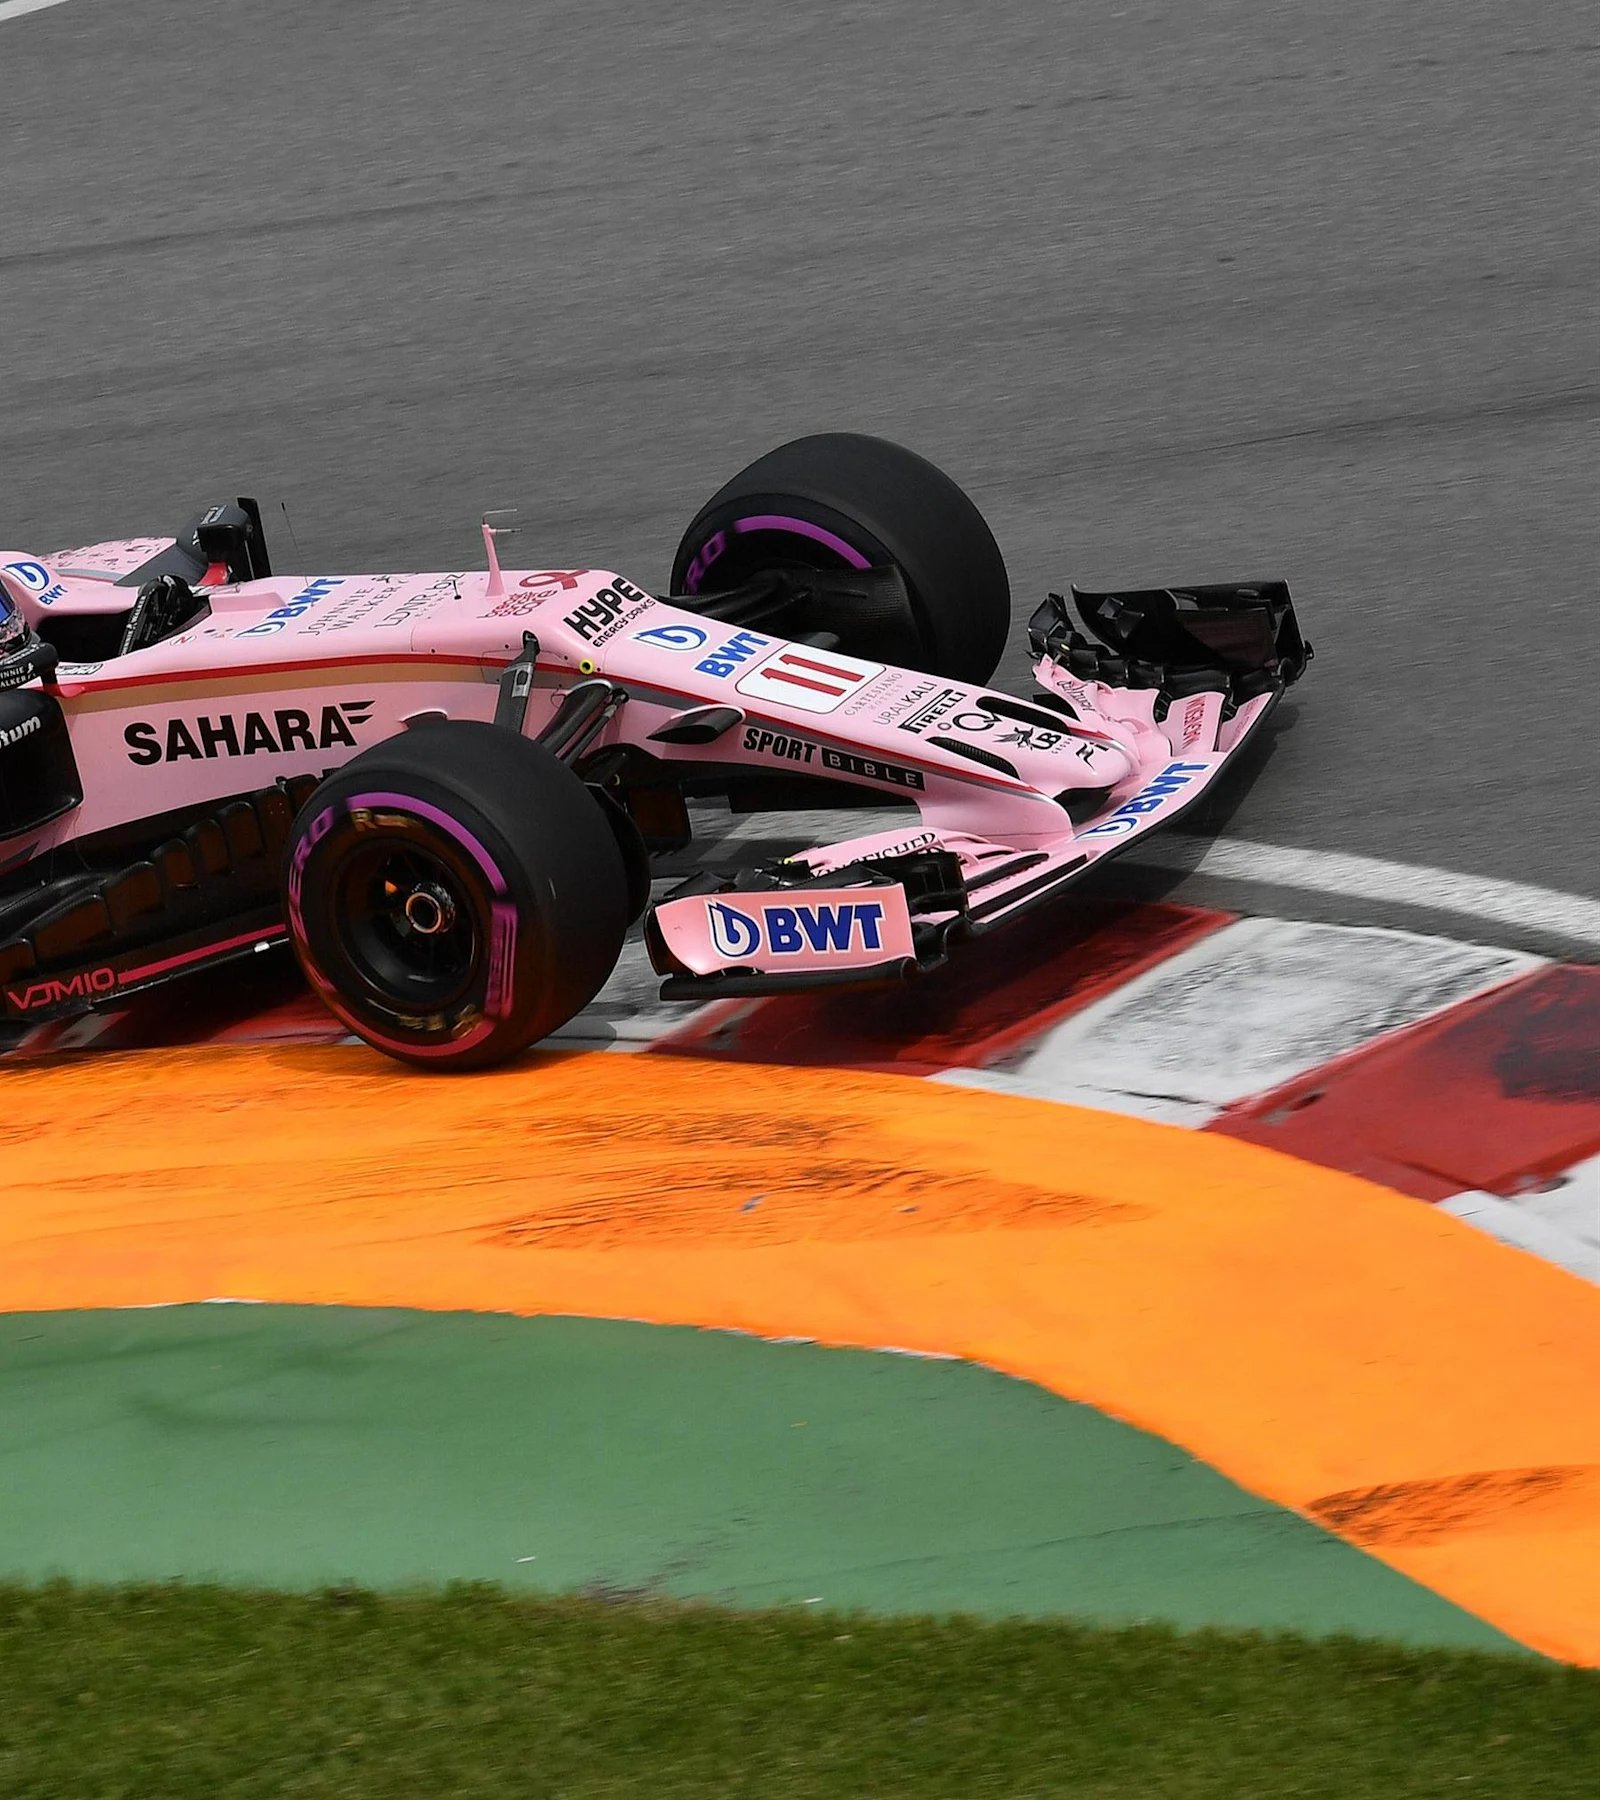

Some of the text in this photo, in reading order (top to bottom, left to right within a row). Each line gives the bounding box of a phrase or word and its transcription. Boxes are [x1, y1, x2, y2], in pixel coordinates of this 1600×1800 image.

[38, 584, 69, 606] BWT
[266, 578, 347, 619] BWT
[298, 587, 374, 636] JOHNNIE
[327, 587, 400, 632] WALKER
[563, 577, 645, 641] HYPE
[592, 598, 657, 648] ENERGY DRINKS
[695, 632, 770, 678] BWT
[760, 653, 866, 697] 11
[845, 673, 903, 716] CARTESIANO
[873, 681, 938, 725] URALKALI
[897, 688, 968, 734] PIRELLI
[123, 704, 362, 766] SAHARA
[744, 728, 817, 764] SPORT
[829, 752, 918, 787] BIBLE
[1111, 762, 1211, 817] BWT
[767, 903, 883, 953] BWT
[8, 967, 117, 1011] VJM10
